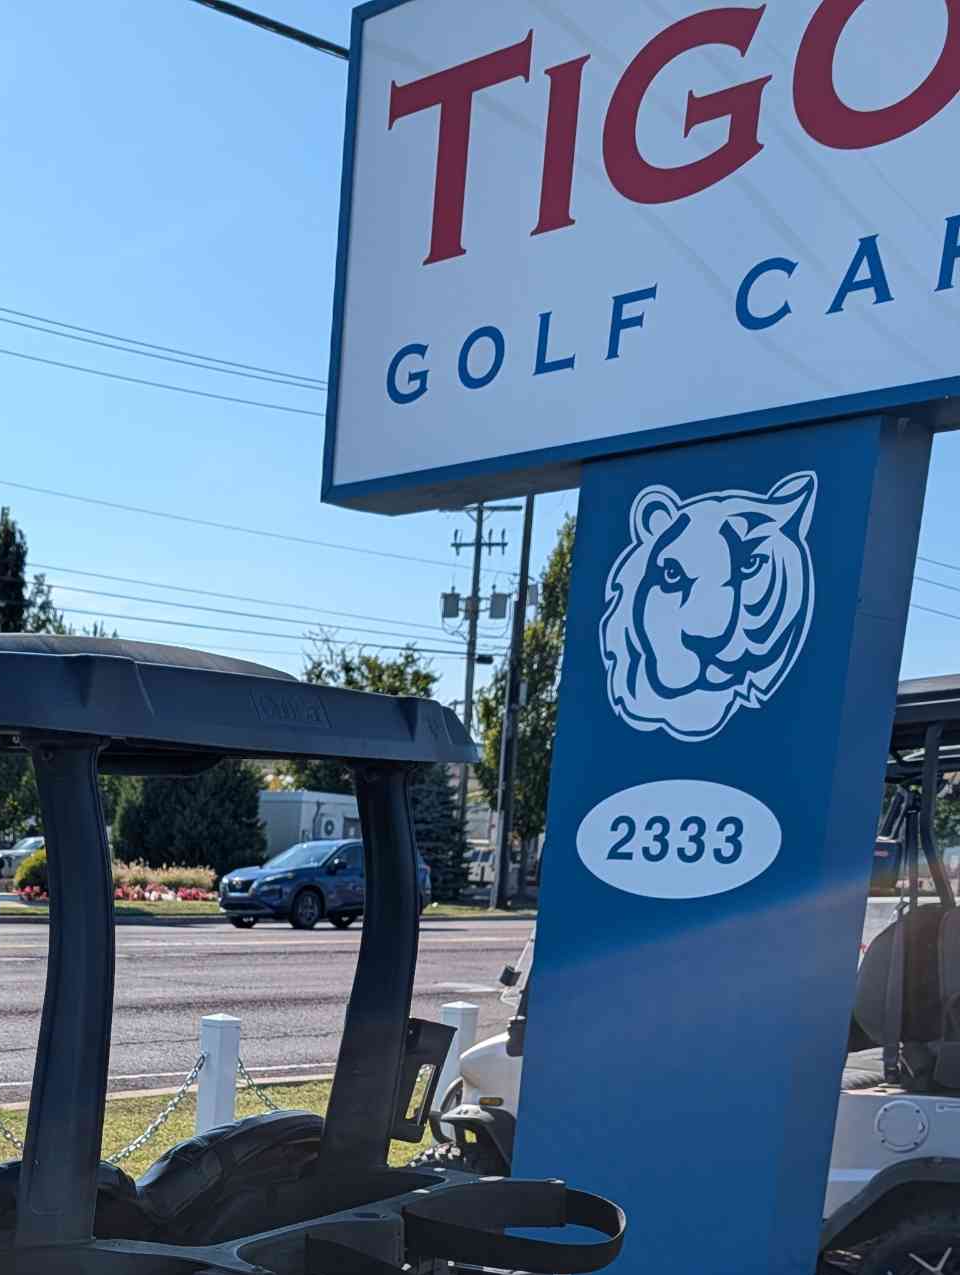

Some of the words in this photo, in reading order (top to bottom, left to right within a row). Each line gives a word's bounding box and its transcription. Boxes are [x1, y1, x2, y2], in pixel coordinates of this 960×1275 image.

[388, 0, 960, 266] TIGO
[386, 283, 658, 404] GOLF
[606, 815, 744, 864] 2333
